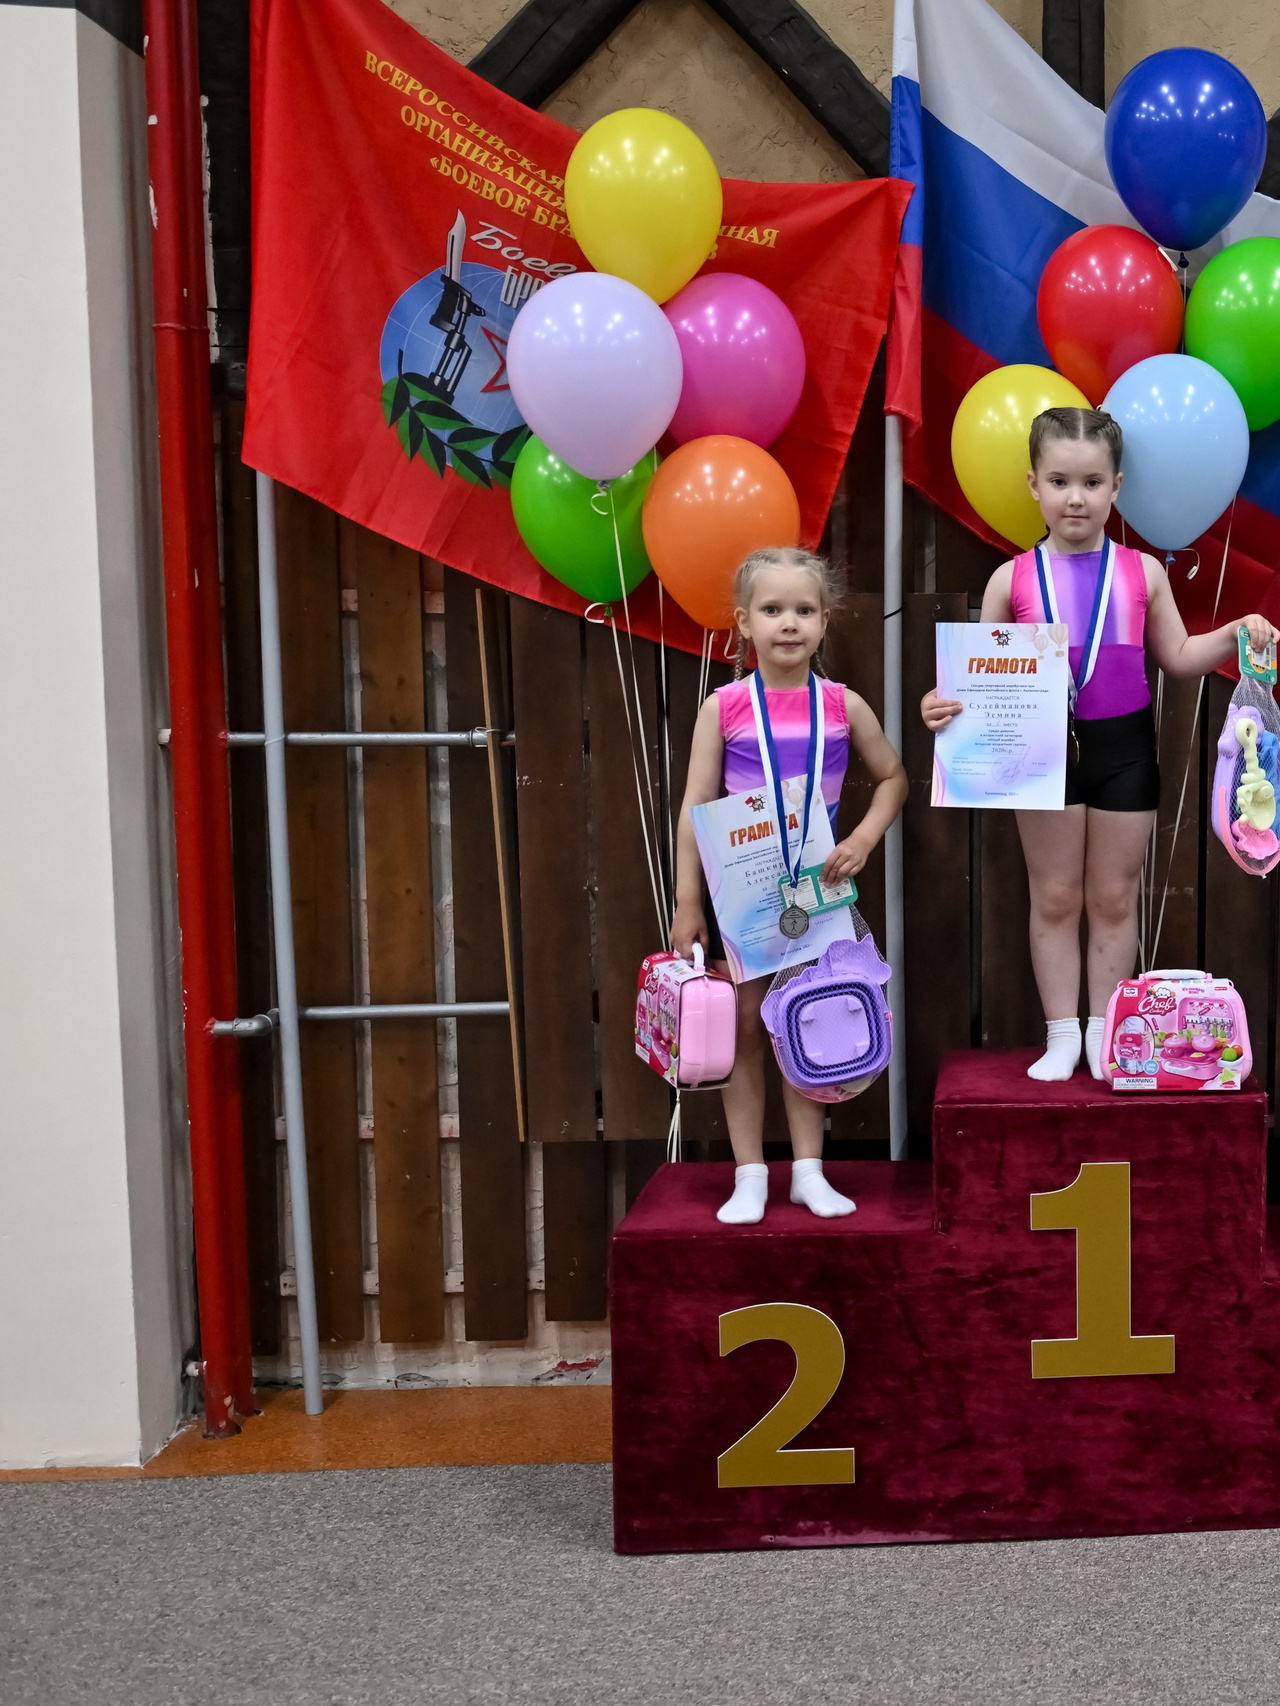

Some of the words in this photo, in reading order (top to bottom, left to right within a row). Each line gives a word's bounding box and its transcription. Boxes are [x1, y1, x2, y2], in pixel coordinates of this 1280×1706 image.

[365, 50, 565, 191] ВСЕРОССИЙСКАЯ
[400, 105, 567, 212] ОРГАНИЗАЦИЯ
[429, 154, 531, 217] «БОЕВОЕ
[470, 220, 578, 279] Боев
[968, 657, 1037, 674] ГРАМОТА
[969, 702, 1038, 711] Сулейманова
[729, 813, 799, 848] ГРАМА
[746, 864, 805, 886] Алексана
[1138, 996, 1175, 1012] Chef
[1030, 1161, 1176, 1379] 1
[717, 1302, 856, 1490] 2
